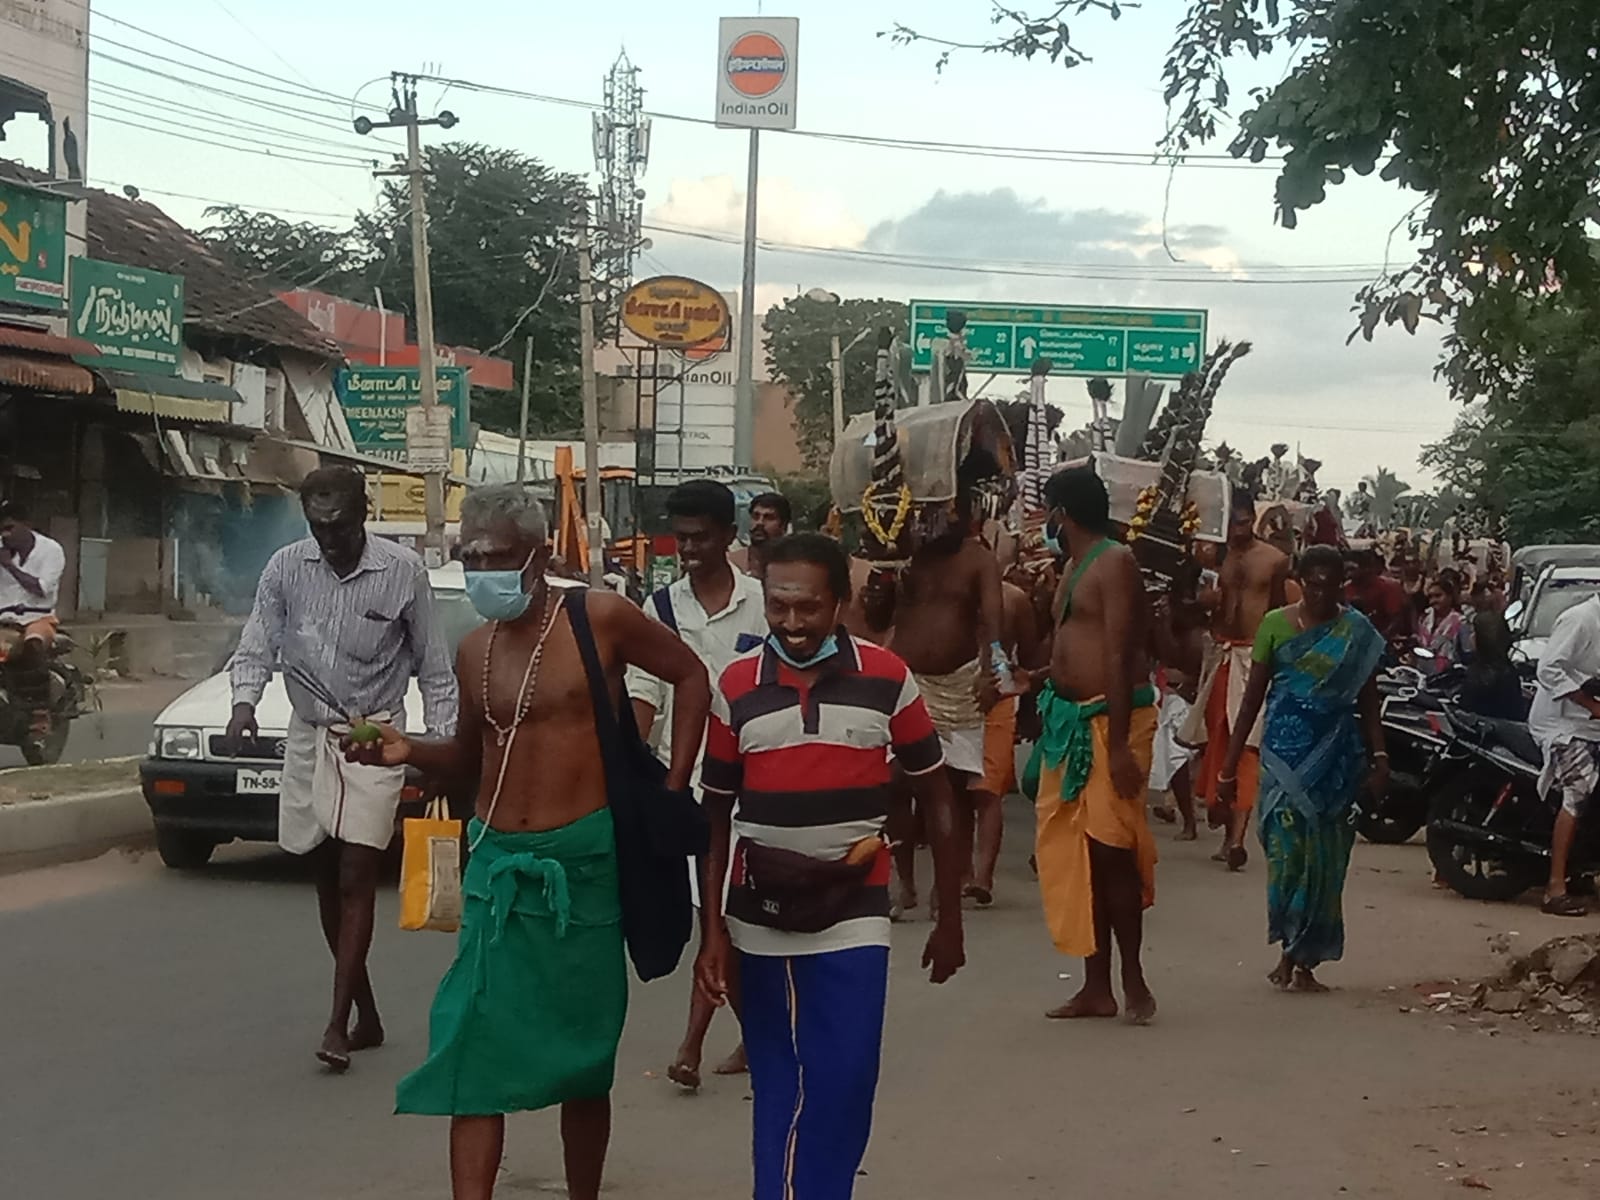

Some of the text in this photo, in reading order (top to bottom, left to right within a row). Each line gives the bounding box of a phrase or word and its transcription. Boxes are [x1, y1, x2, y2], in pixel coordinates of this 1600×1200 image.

[721, 102, 788, 115] IndianOil
[685, 370, 732, 385] ianOil
[346, 406, 406, 419] MEENAKSH
[242, 776, 282, 789] TN-59-
